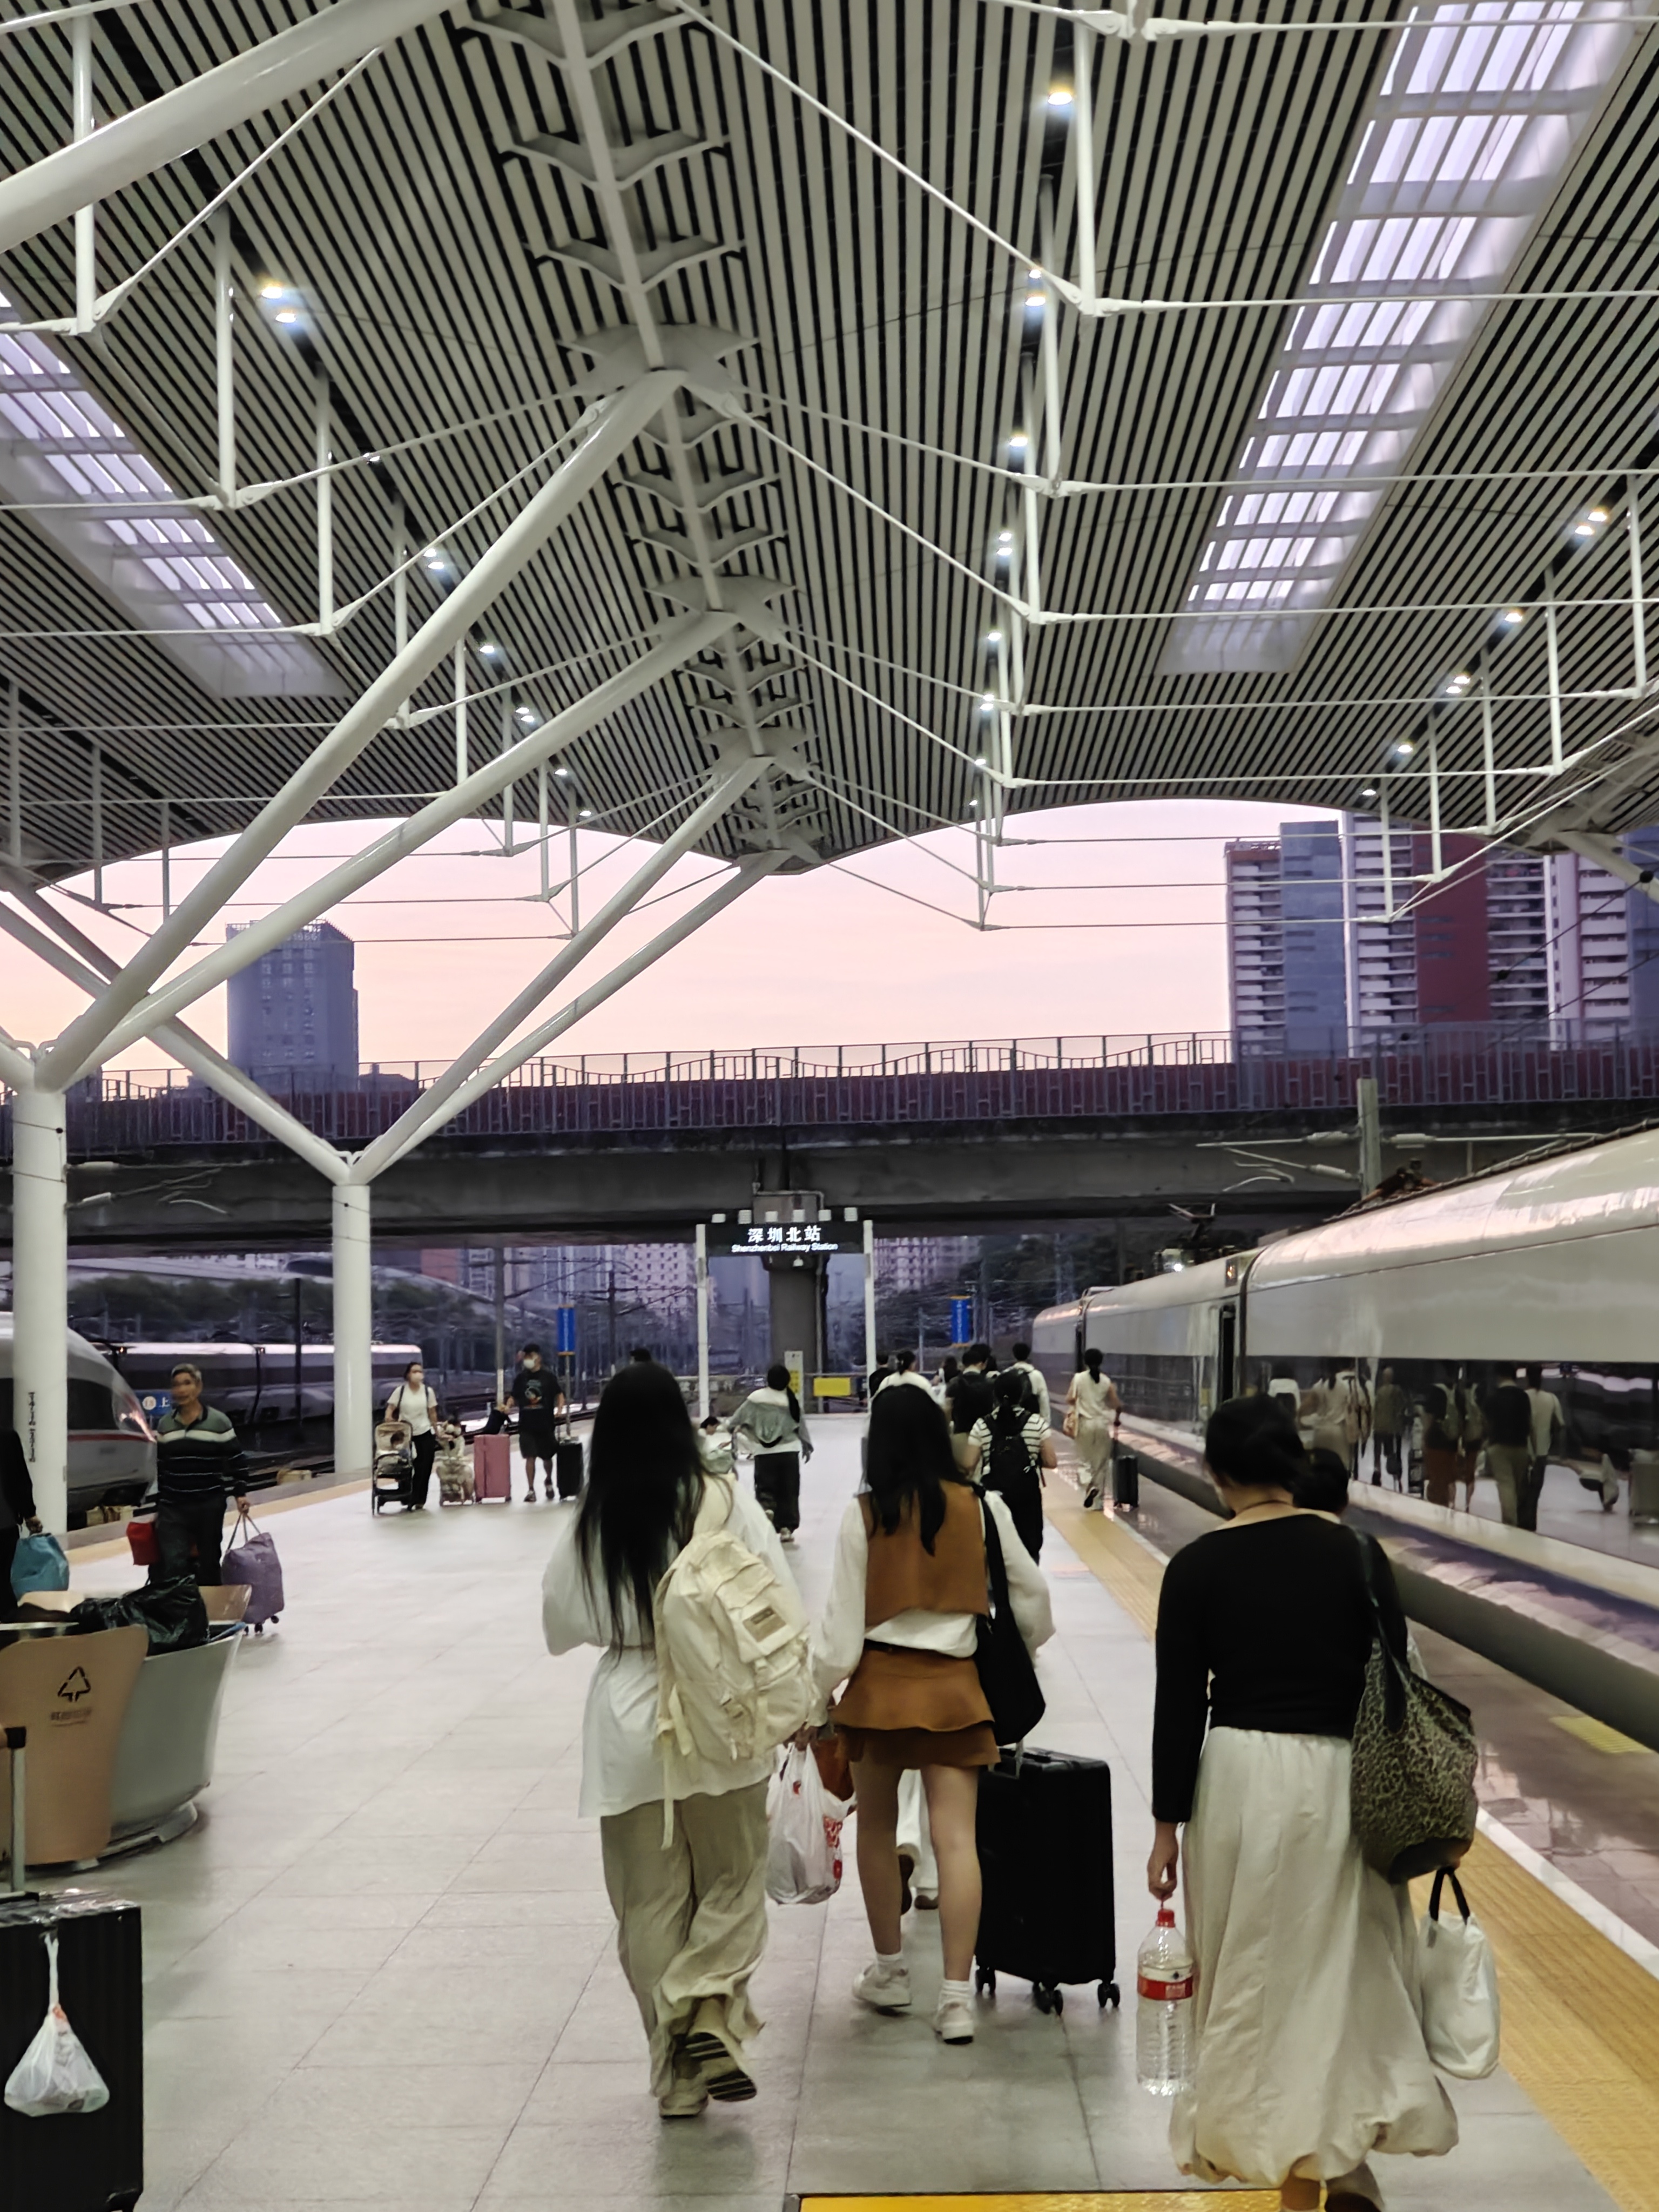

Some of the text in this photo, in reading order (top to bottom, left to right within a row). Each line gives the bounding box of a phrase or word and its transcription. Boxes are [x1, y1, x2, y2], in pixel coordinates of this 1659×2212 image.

[747, 1225, 821, 1243] 深圳北站
[780, 1243, 810, 1252] Railway
[811, 1242, 838, 1251] Station
